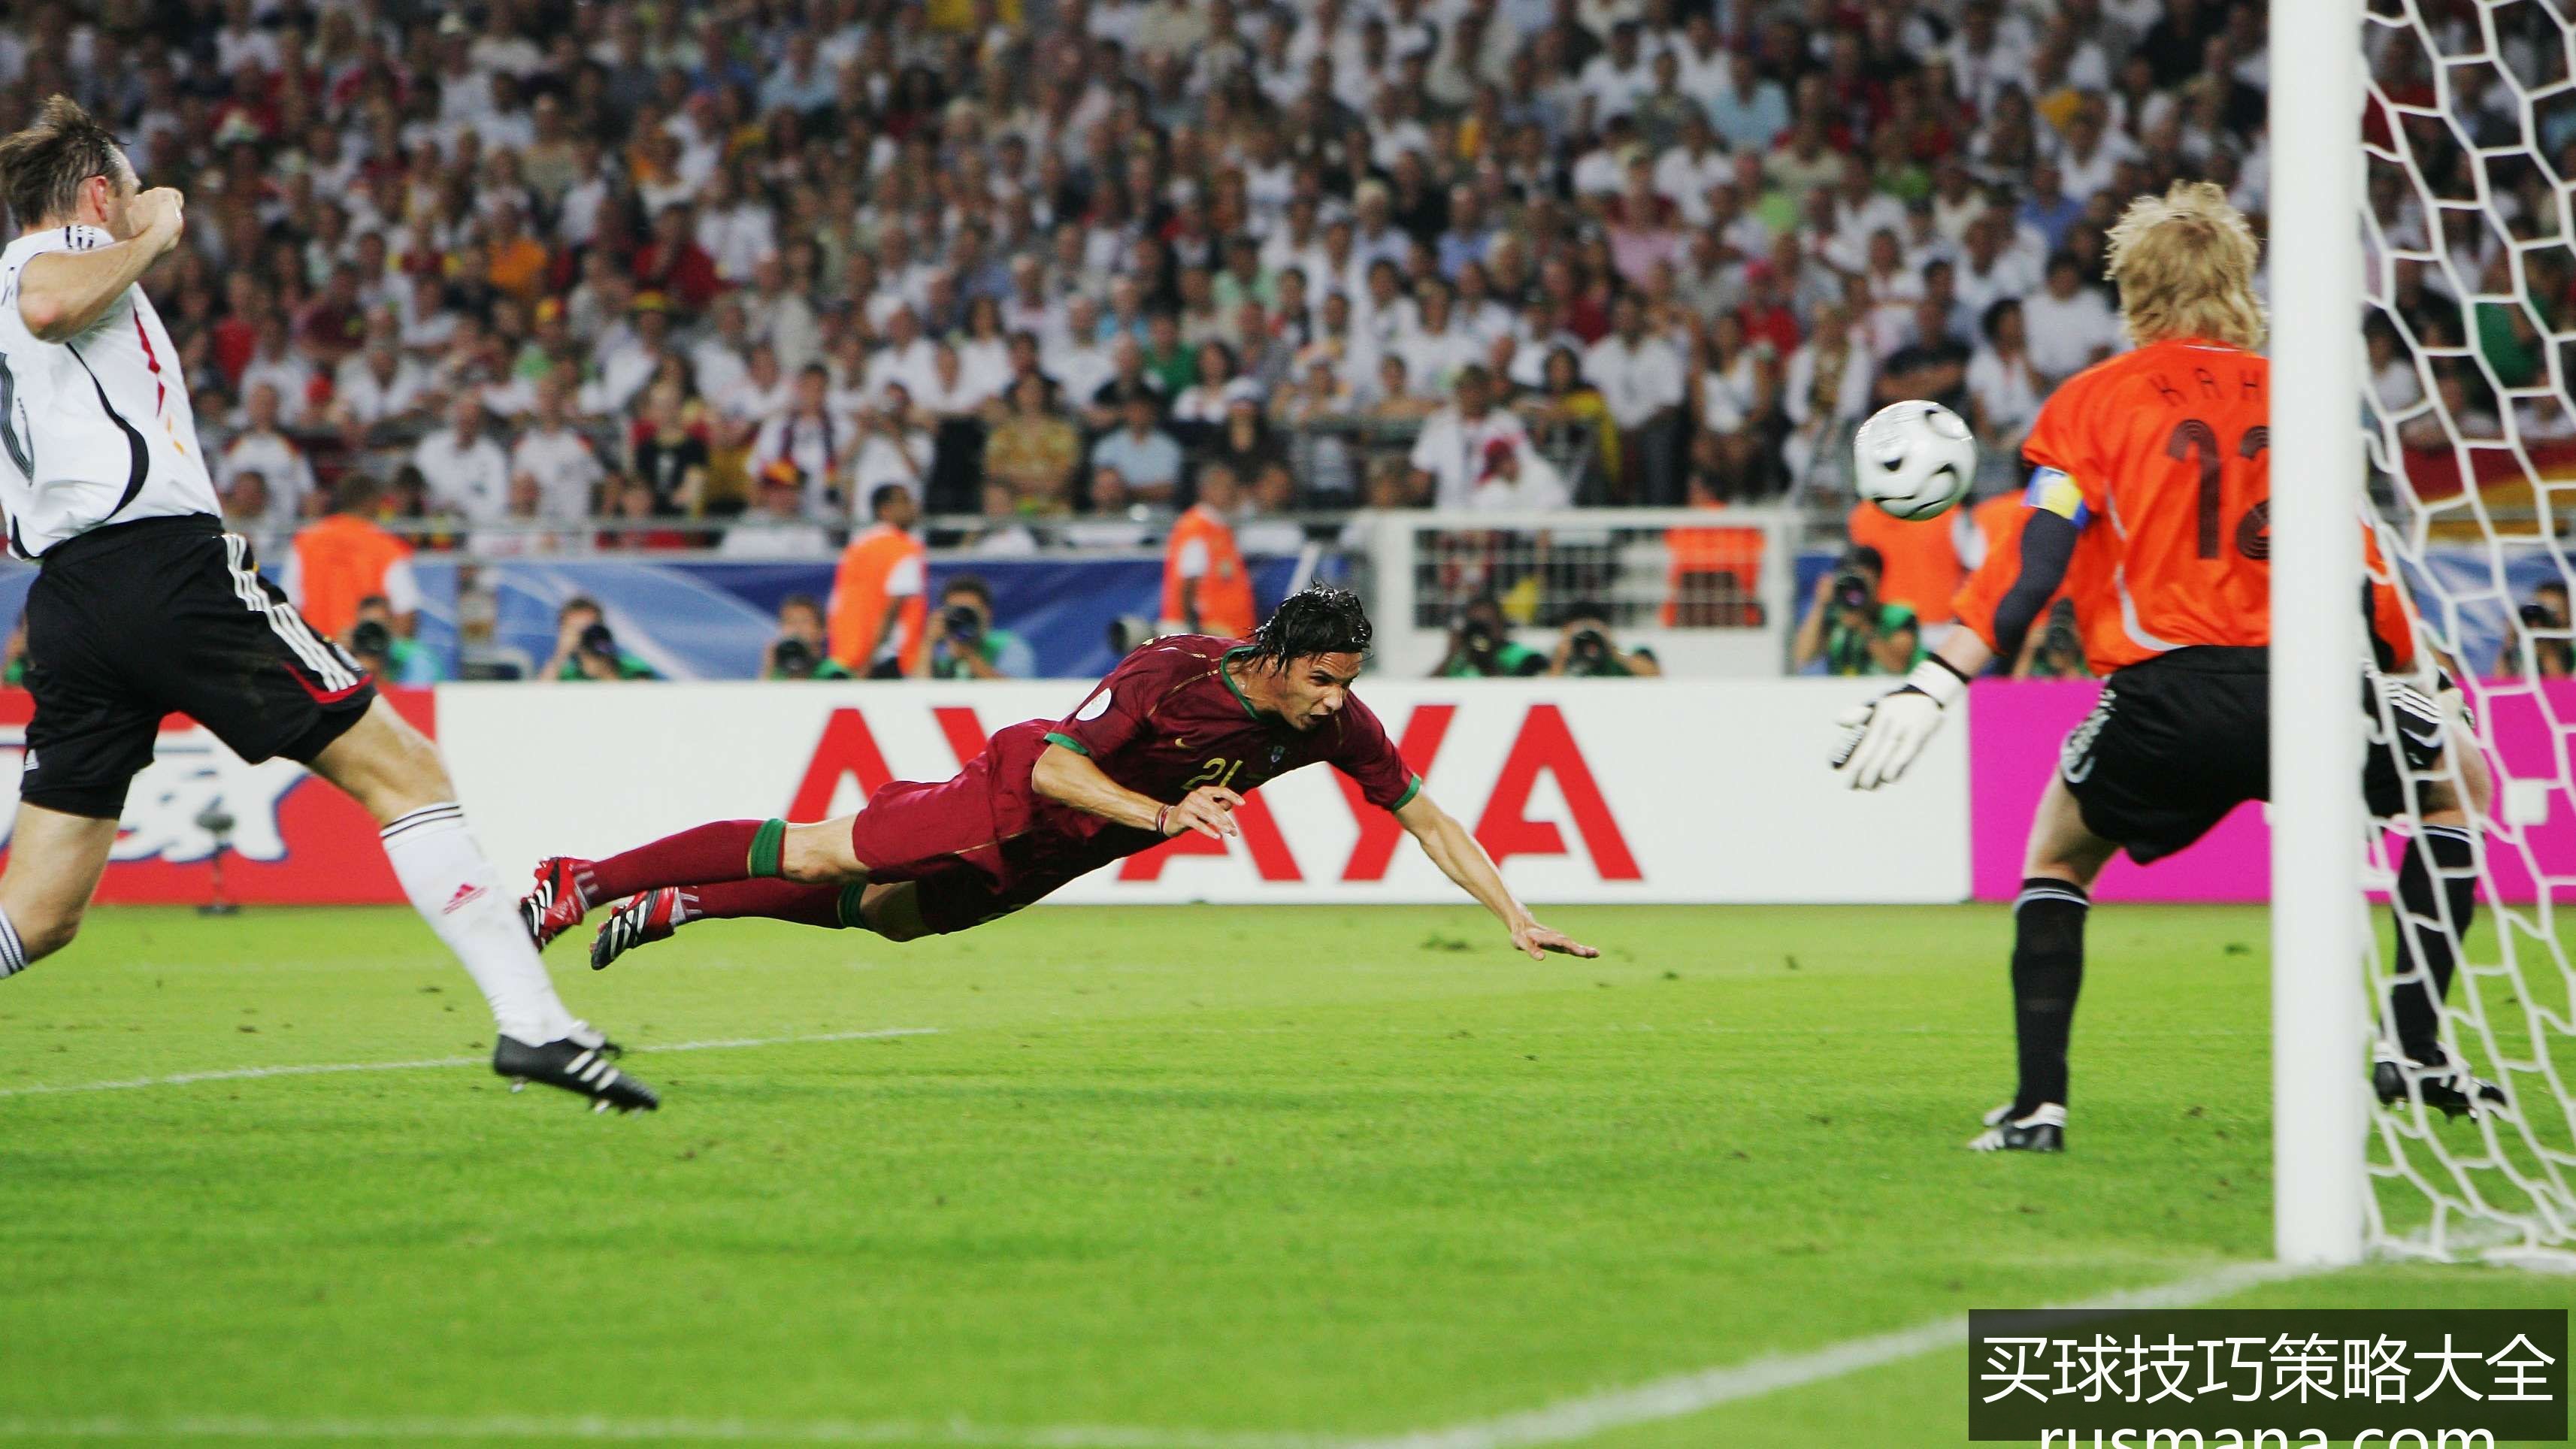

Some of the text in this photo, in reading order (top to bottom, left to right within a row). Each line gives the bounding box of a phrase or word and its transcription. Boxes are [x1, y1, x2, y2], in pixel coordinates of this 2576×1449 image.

[2166, 419, 2269, 561] 12
[786, 705, 1642, 880] AAYA
[1180, 757, 1243, 790] 21
